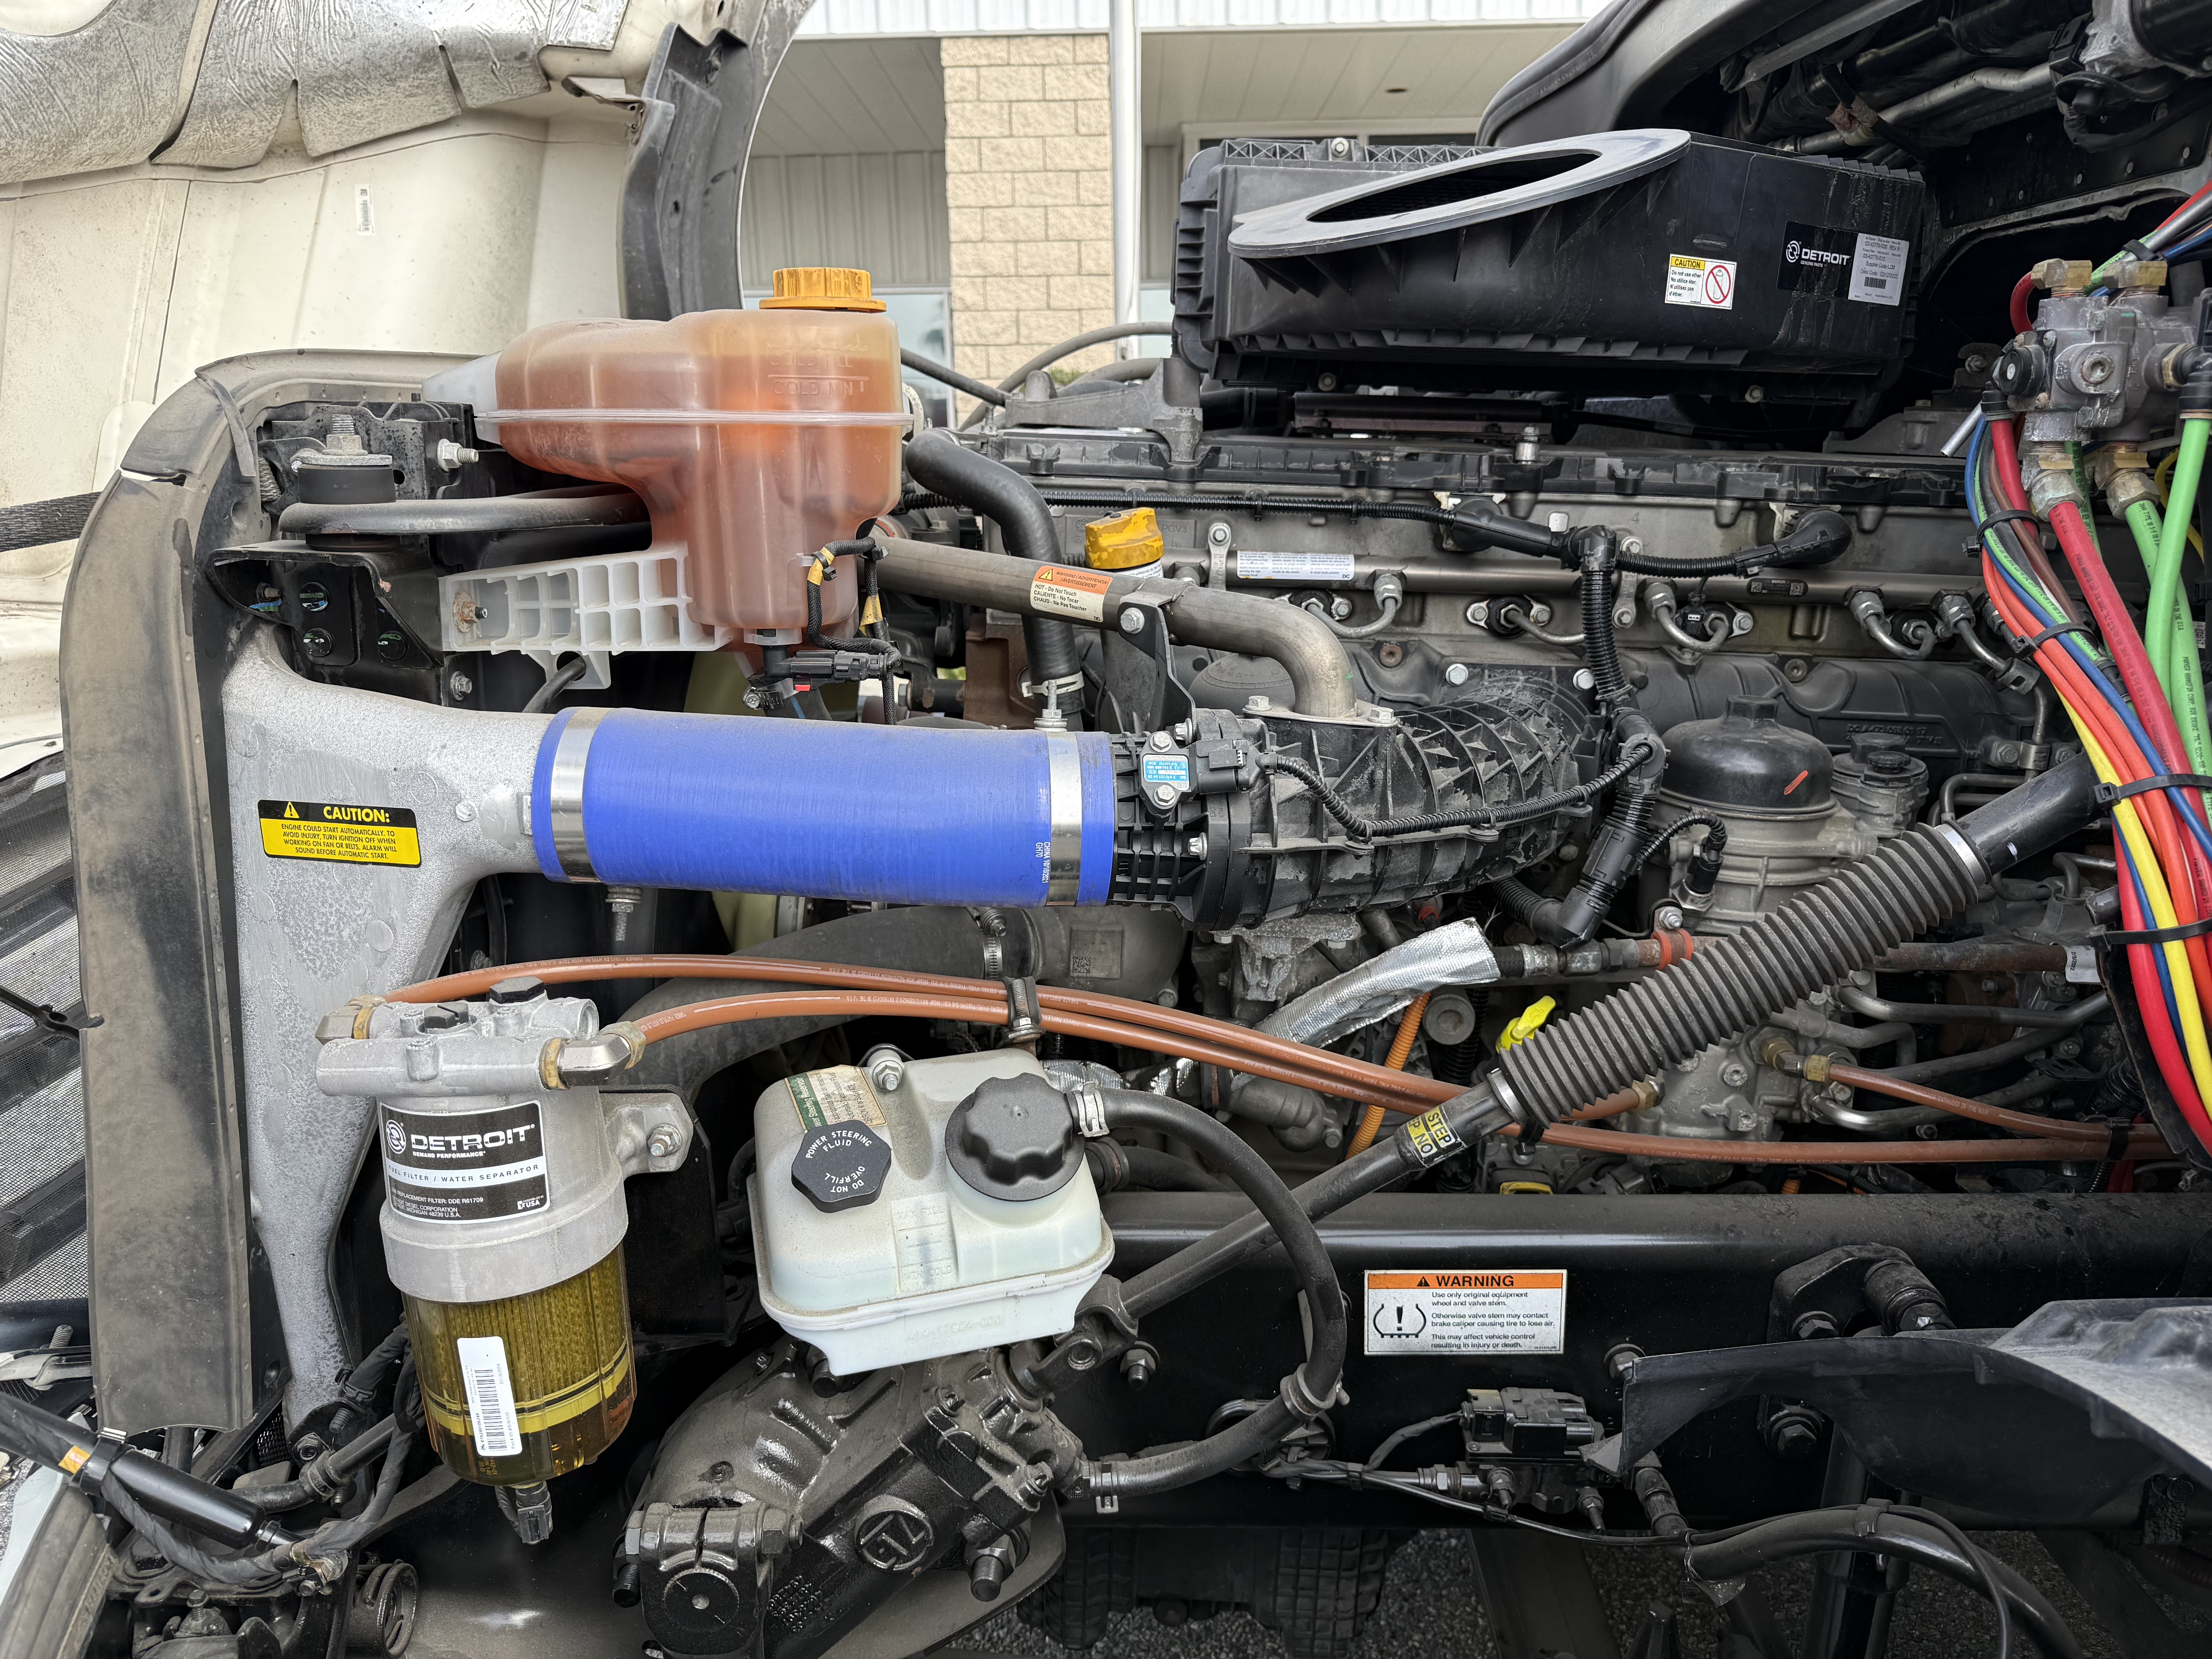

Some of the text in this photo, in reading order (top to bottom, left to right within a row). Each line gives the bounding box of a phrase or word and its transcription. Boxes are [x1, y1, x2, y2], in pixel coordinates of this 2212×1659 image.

[1675, 259, 1700, 268] CAUTION
[1802, 249, 1850, 265] DETROIT
[773, 381, 819, 395] COLD
[1034, 590, 1056, 599] CALIENTE
[2190, 718, 2199, 732] BRAKE
[323, 806, 390, 823] CAUTION:
[340, 827, 385, 836] AUTOMATICALLY.
[338, 850, 370, 858] AUTOMATIC
[829, 1072, 838, 1080] Fluid
[795, 1077, 818, 1117] Steering Reservoir
[1427, 1112, 1452, 1143] STEP
[410, 1125, 531, 1151] DETROIT
[805, 1130, 872, 1159] POWER STEERING
[1414, 1133, 1433, 1154] NO
[823, 1139, 852, 1152] FLUID
[389, 1165, 401, 1175] FUEL
[404, 1171, 429, 1181] FILTER
[479, 1164, 538, 1180] SEPARATOR
[824, 1166, 865, 1184] OVERFILL
[852, 1180, 864, 1189] DO
[397, 1189, 427, 1202] REPLACEMENT
[405, 1201, 419, 1209] DIESEL
[526, 1199, 540, 1208] USA
[406, 1206, 428, 1216] MICHIGAN
[1436, 1275, 1514, 1287] WARNING
